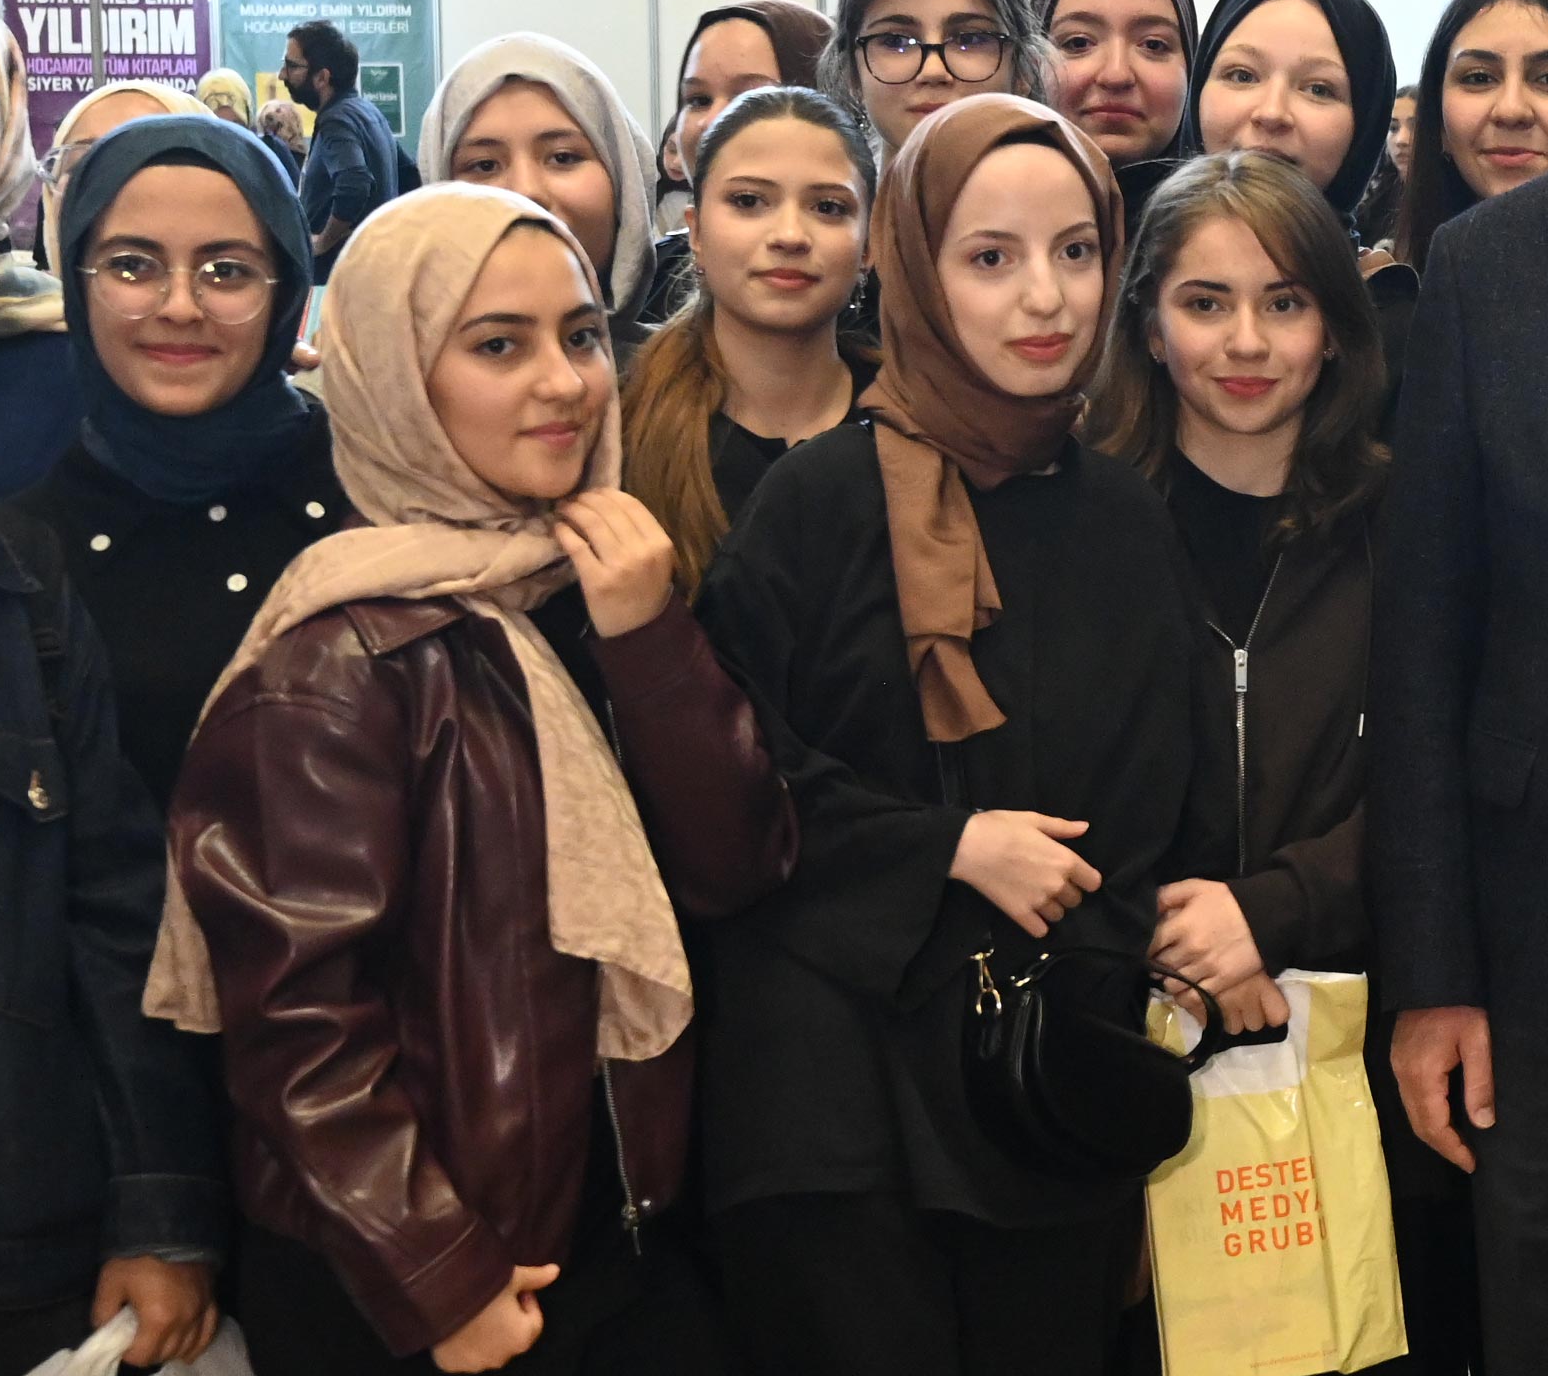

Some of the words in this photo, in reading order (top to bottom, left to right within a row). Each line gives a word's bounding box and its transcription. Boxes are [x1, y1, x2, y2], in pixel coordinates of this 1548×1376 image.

[240, 3, 317, 17] MUHAMMED
[320, 3, 352, 17] EMİN
[358, 3, 412, 17] YILDIRIM
[18, 7, 196, 55] YILDIRIM
[350, 20, 409, 34] ESERLERİ
[103, 57, 130, 75] TÜM
[132, 57, 197, 75] KİTAPLARI
[27, 76, 72, 92] SİYER
